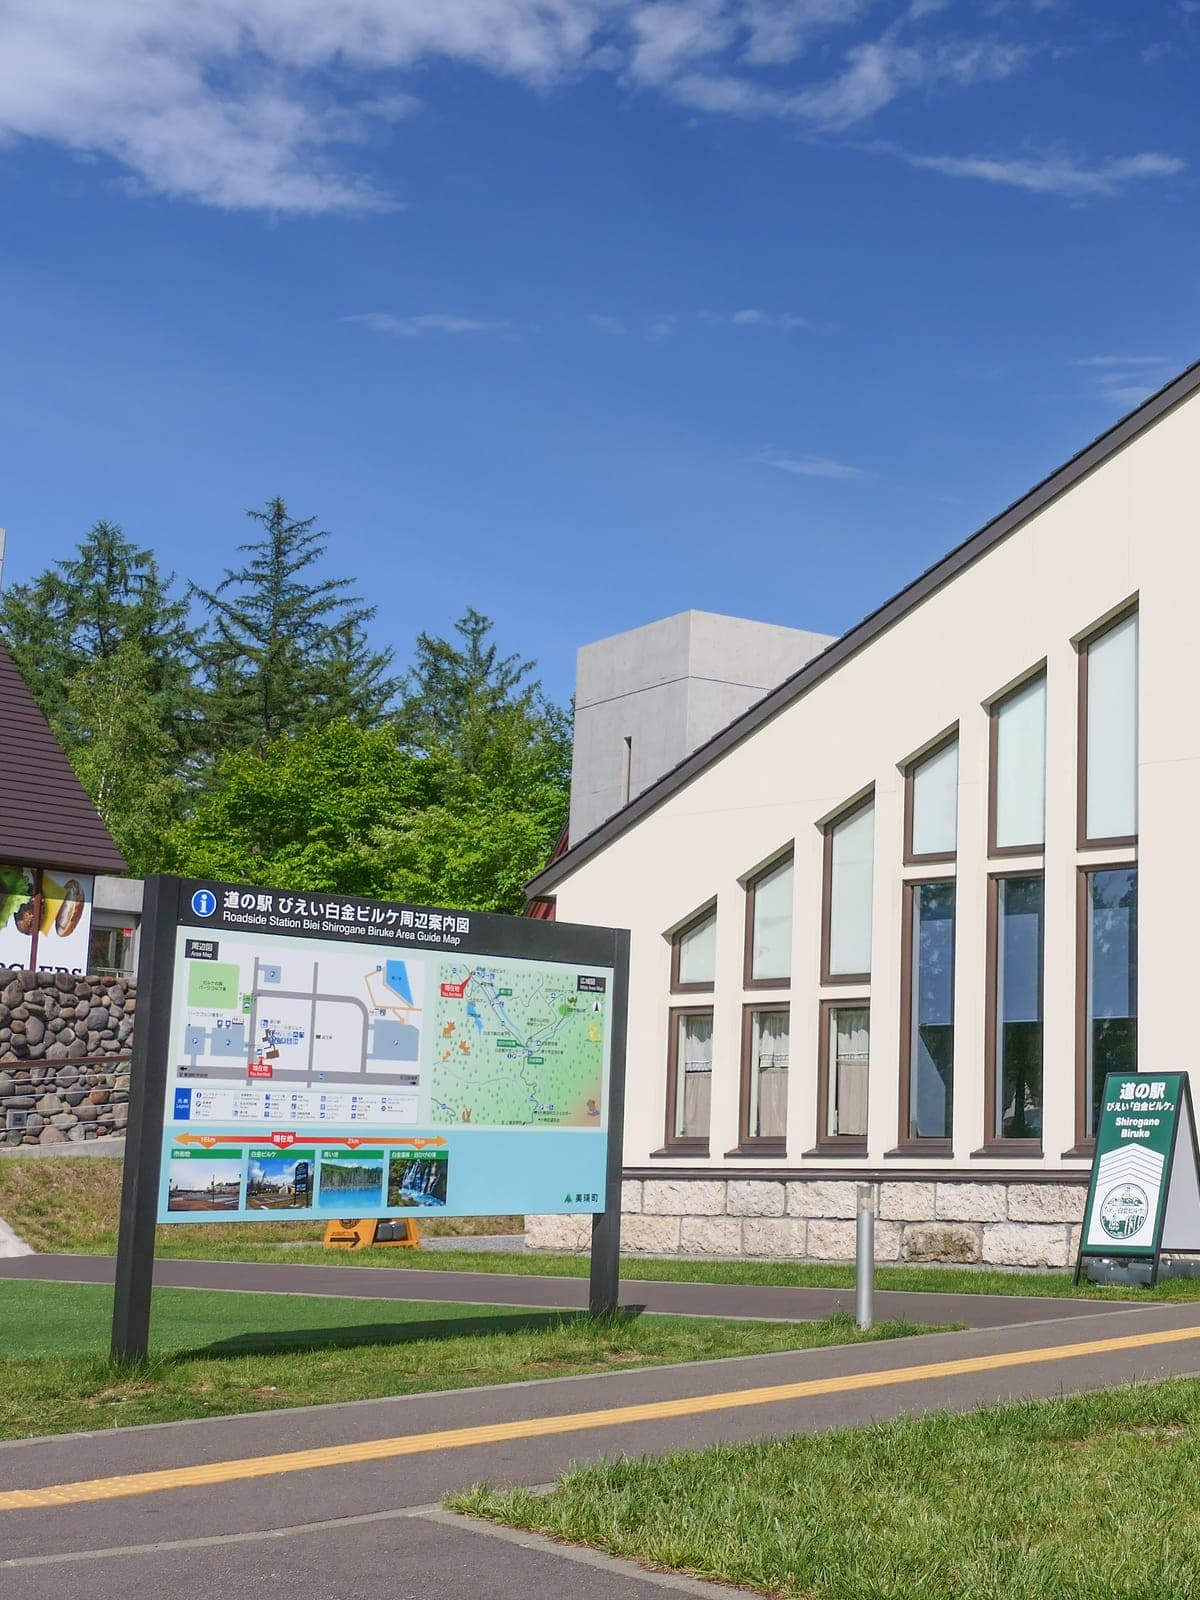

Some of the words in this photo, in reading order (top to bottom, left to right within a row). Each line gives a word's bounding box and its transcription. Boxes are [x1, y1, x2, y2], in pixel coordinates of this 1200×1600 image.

[223, 890, 273, 912] 道の駅
[278, 897, 470, 934] びえい白金ビルケ周辺案内図
[222, 911, 267, 926] Roadside
[269, 915, 301, 929] Station
[303, 919, 320, 930] Biei
[321, 921, 366, 936] Shirogane
[367, 925, 395, 938] Biruke
[395, 928, 415, 940] Area
[417, 931, 441, 943] Guide
[442, 934, 461, 946] Map
[1119, 1082, 1166, 1100] 道の駅
[1115, 1116, 1160, 1128] Shirogane
[1121, 1128, 1151, 1138] Biruke
